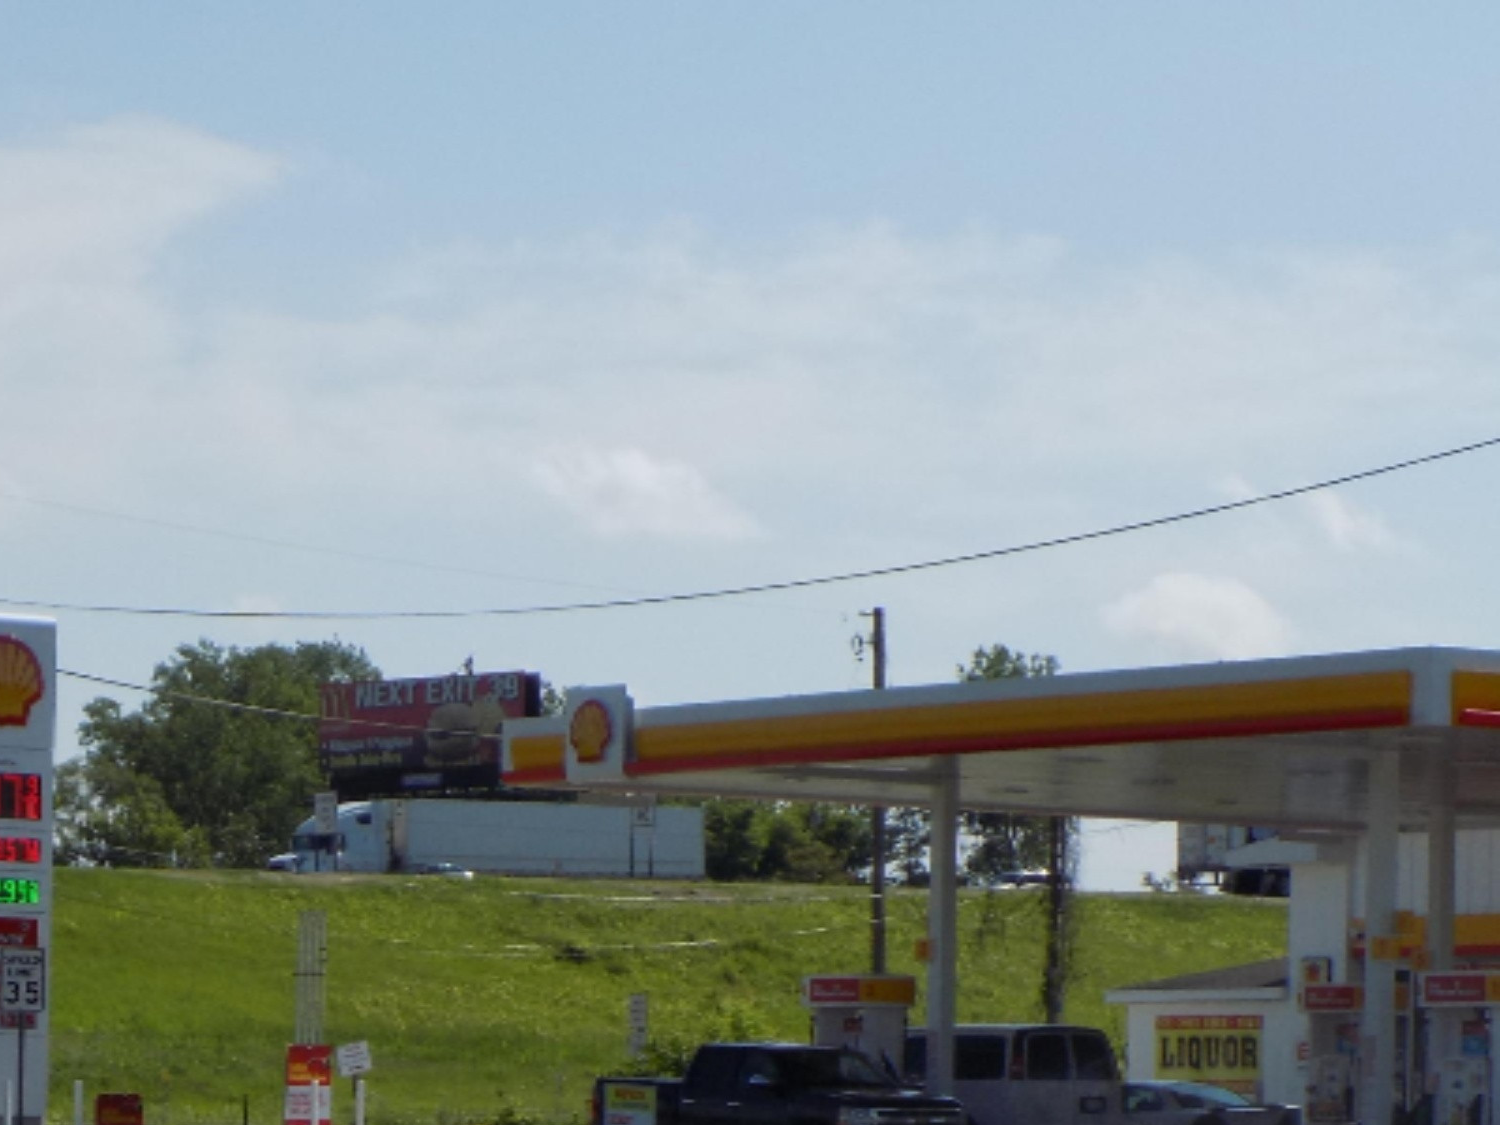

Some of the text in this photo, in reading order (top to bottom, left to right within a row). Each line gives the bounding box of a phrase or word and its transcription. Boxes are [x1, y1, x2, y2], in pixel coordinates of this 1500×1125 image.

[355, 679, 419, 708] NEXT
[425, 674, 476, 704] EXIT
[5, 980, 39, 1005] 35
[1161, 1034, 1258, 1069] LIQUOR
